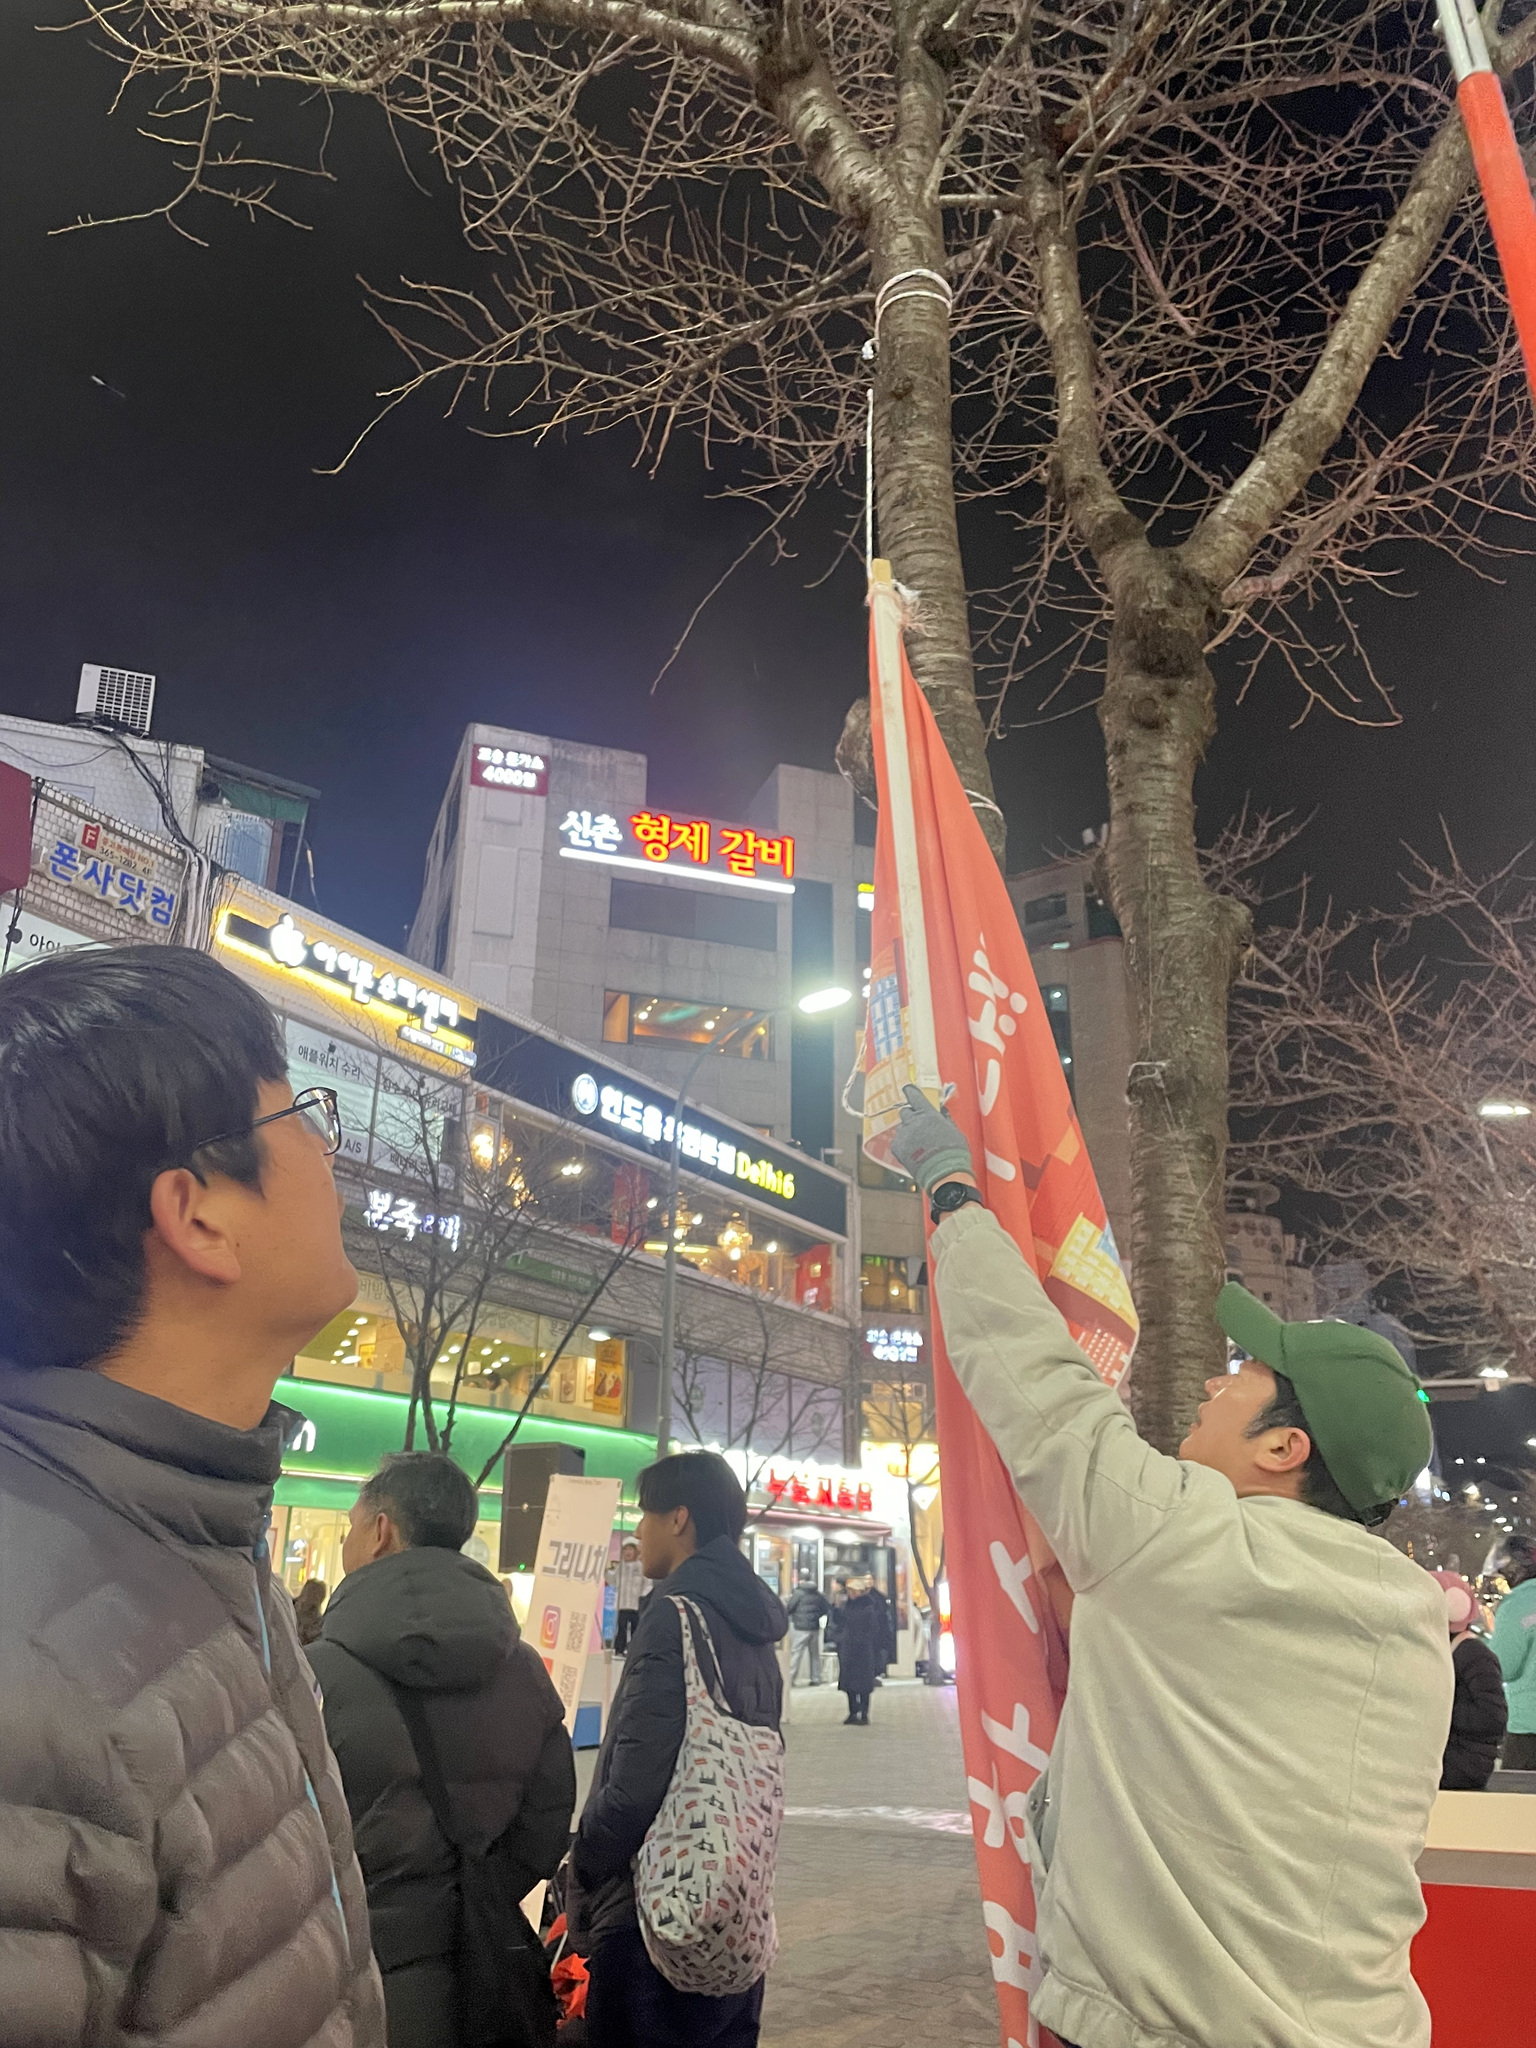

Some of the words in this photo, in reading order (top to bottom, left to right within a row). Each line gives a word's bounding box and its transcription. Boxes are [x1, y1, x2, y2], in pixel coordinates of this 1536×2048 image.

[559, 810, 623, 852] 신촌
[629, 811, 711, 864] 형제
[718, 829, 796, 879] 갈비
[49, 840, 175, 926] 폰사닷컴
[313, 941, 374, 1004] 아이폰
[298, 1045, 339, 1072] 애플워치
[341, 1063, 361, 1081] 수리
[344, 1138, 363, 1154] A/S
[735, 1151, 795, 1199] Delhi6
